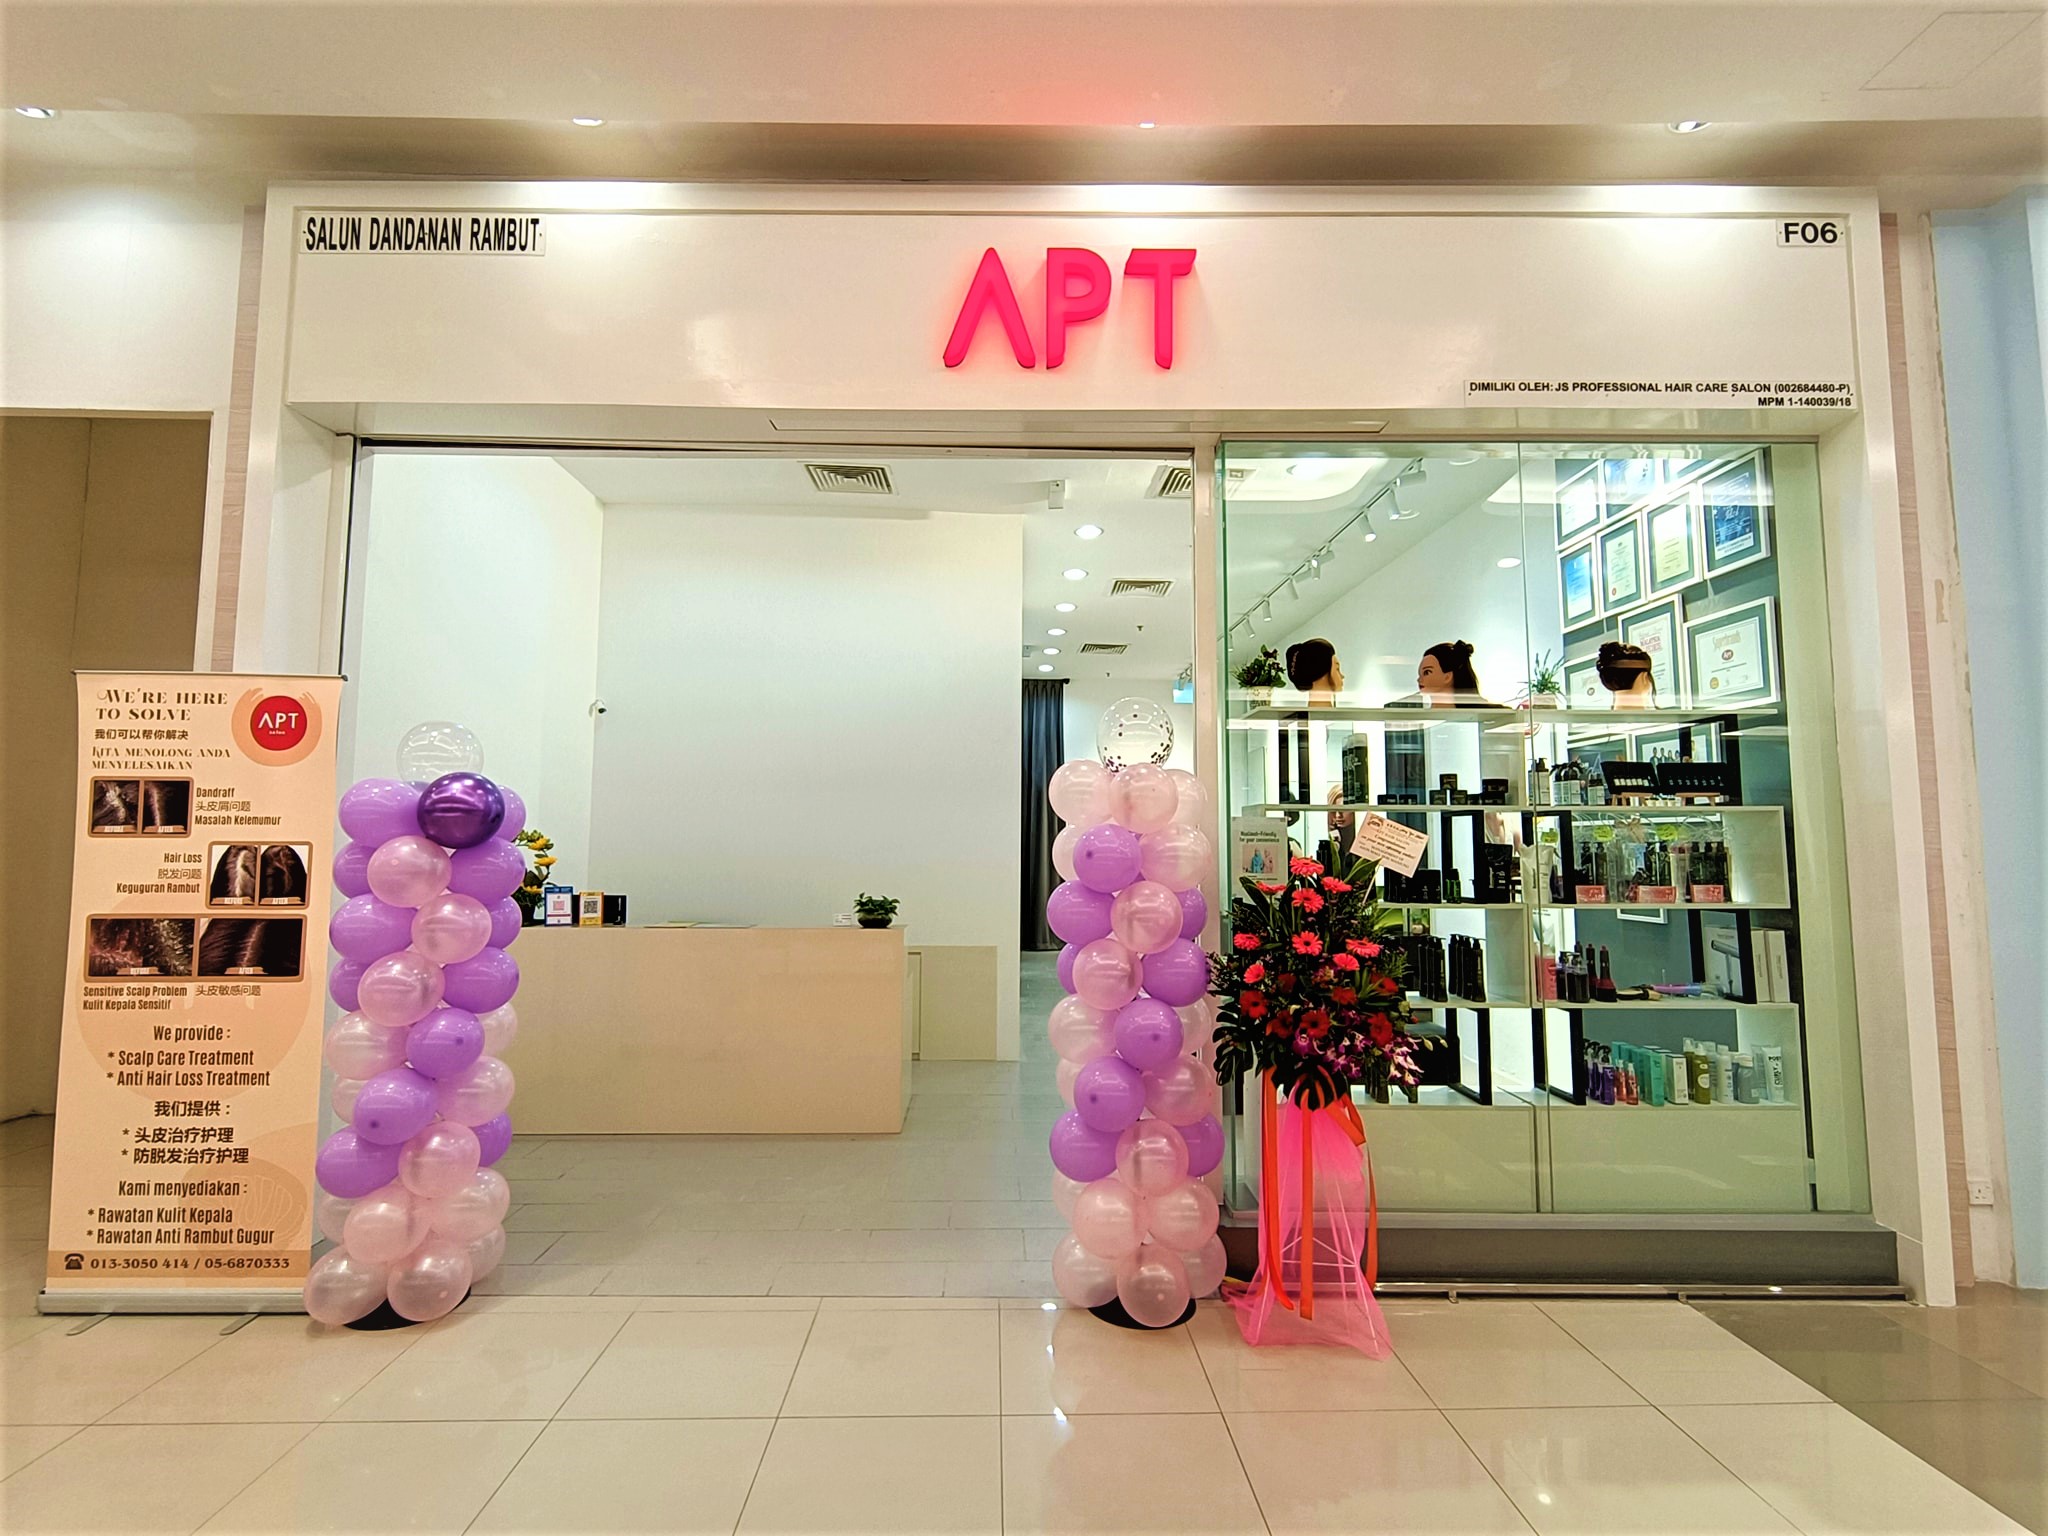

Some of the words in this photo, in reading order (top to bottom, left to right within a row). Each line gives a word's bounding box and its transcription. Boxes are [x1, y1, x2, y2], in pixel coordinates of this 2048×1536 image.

[306, 217, 361, 251] SALUN
[369, 217, 462, 251] DANDANAN
[469, 218, 539, 251] RAMBUT
[1784, 222, 1838, 244] F06
[943, 247, 1197, 370] APT
[1469, 382, 1516, 392] DIMILIKI
[1518, 382, 1554, 392] OLEH:
[1555, 382, 1569, 392] JS
[1572, 382, 1661, 393] PROFESSIONAL
[1665, 383, 1693, 393] HAIR
[1695, 383, 1728, 393] CARE
[1731, 383, 1771, 393] SALON
[1774, 383, 1851, 395] (002684480-P)
[1757, 397, 1785, 407] MPM
[1787, 397, 1852, 407] 1-140039/18
[176, 692, 228, 705] HERE
[96, 708, 121, 721] TO
[128, 708, 191, 721] SOLVE
[258, 712, 299, 729] APT
[94, 728, 189, 741] 我们可以帮你解决
[125, 748, 193, 758] MENOLONG
[197, 748, 231, 758] ANDA
[91, 760, 193, 770] MENYELESAIKAN
[196, 787, 235, 798] Dandraff
[195, 801, 251, 812] 头皮屑问题
[195, 815, 232, 826] Masalah
[234, 815, 281, 826] Kelemumur
[164, 853, 181, 863] Hair
[183, 853, 202, 863] Loss
[158, 868, 202, 879] 脱发问题
[116, 882, 165, 894] Keguguran
[167, 883, 200, 894] Rambut
[84, 986, 124, 997] Sensitive
[126, 986, 151, 998] Scalp
[152, 986, 188, 997] Problem
[195, 985, 262, 997] 头皮敏感问题
[83, 1000, 103, 1010] Kulit
[105, 1000, 136, 1012] Kepala
[137, 999, 171, 1010] Sensitif
[153, 1026, 172, 1041] We
[174, 1026, 223, 1043] provide
[118, 1050, 154, 1067] Scalp
[157, 1050, 185, 1065] Care
[188, 1050, 254, 1065] Treatment
[117, 1070, 143, 1086] Anti
[146, 1070, 172, 1086] Hair
[175, 1070, 203, 1086] Loss
[206, 1070, 271, 1086] Treatment
[134, 1127, 234, 1143] 头皮治疗护理
[133, 1148, 249, 1164] 防脱发治疗护理
[118, 1180, 151, 1196] Kami
[153, 1180, 240, 1198] menyediakan
[98, 1207, 153, 1223] Rawatan
[156, 1207, 187, 1223] Kulit
[189, 1207, 233, 1225] Kepala
[96, 1228, 153, 1244] Rawatan
[155, 1228, 181, 1244] Anti
[184, 1228, 234, 1244] Rambut
[236, 1228, 275, 1246] Gugur
[90, 1258, 158, 1270] 013-3050
[162, 1258, 189, 1270] 414
[204, 1257, 290, 1270] 05-6870333
